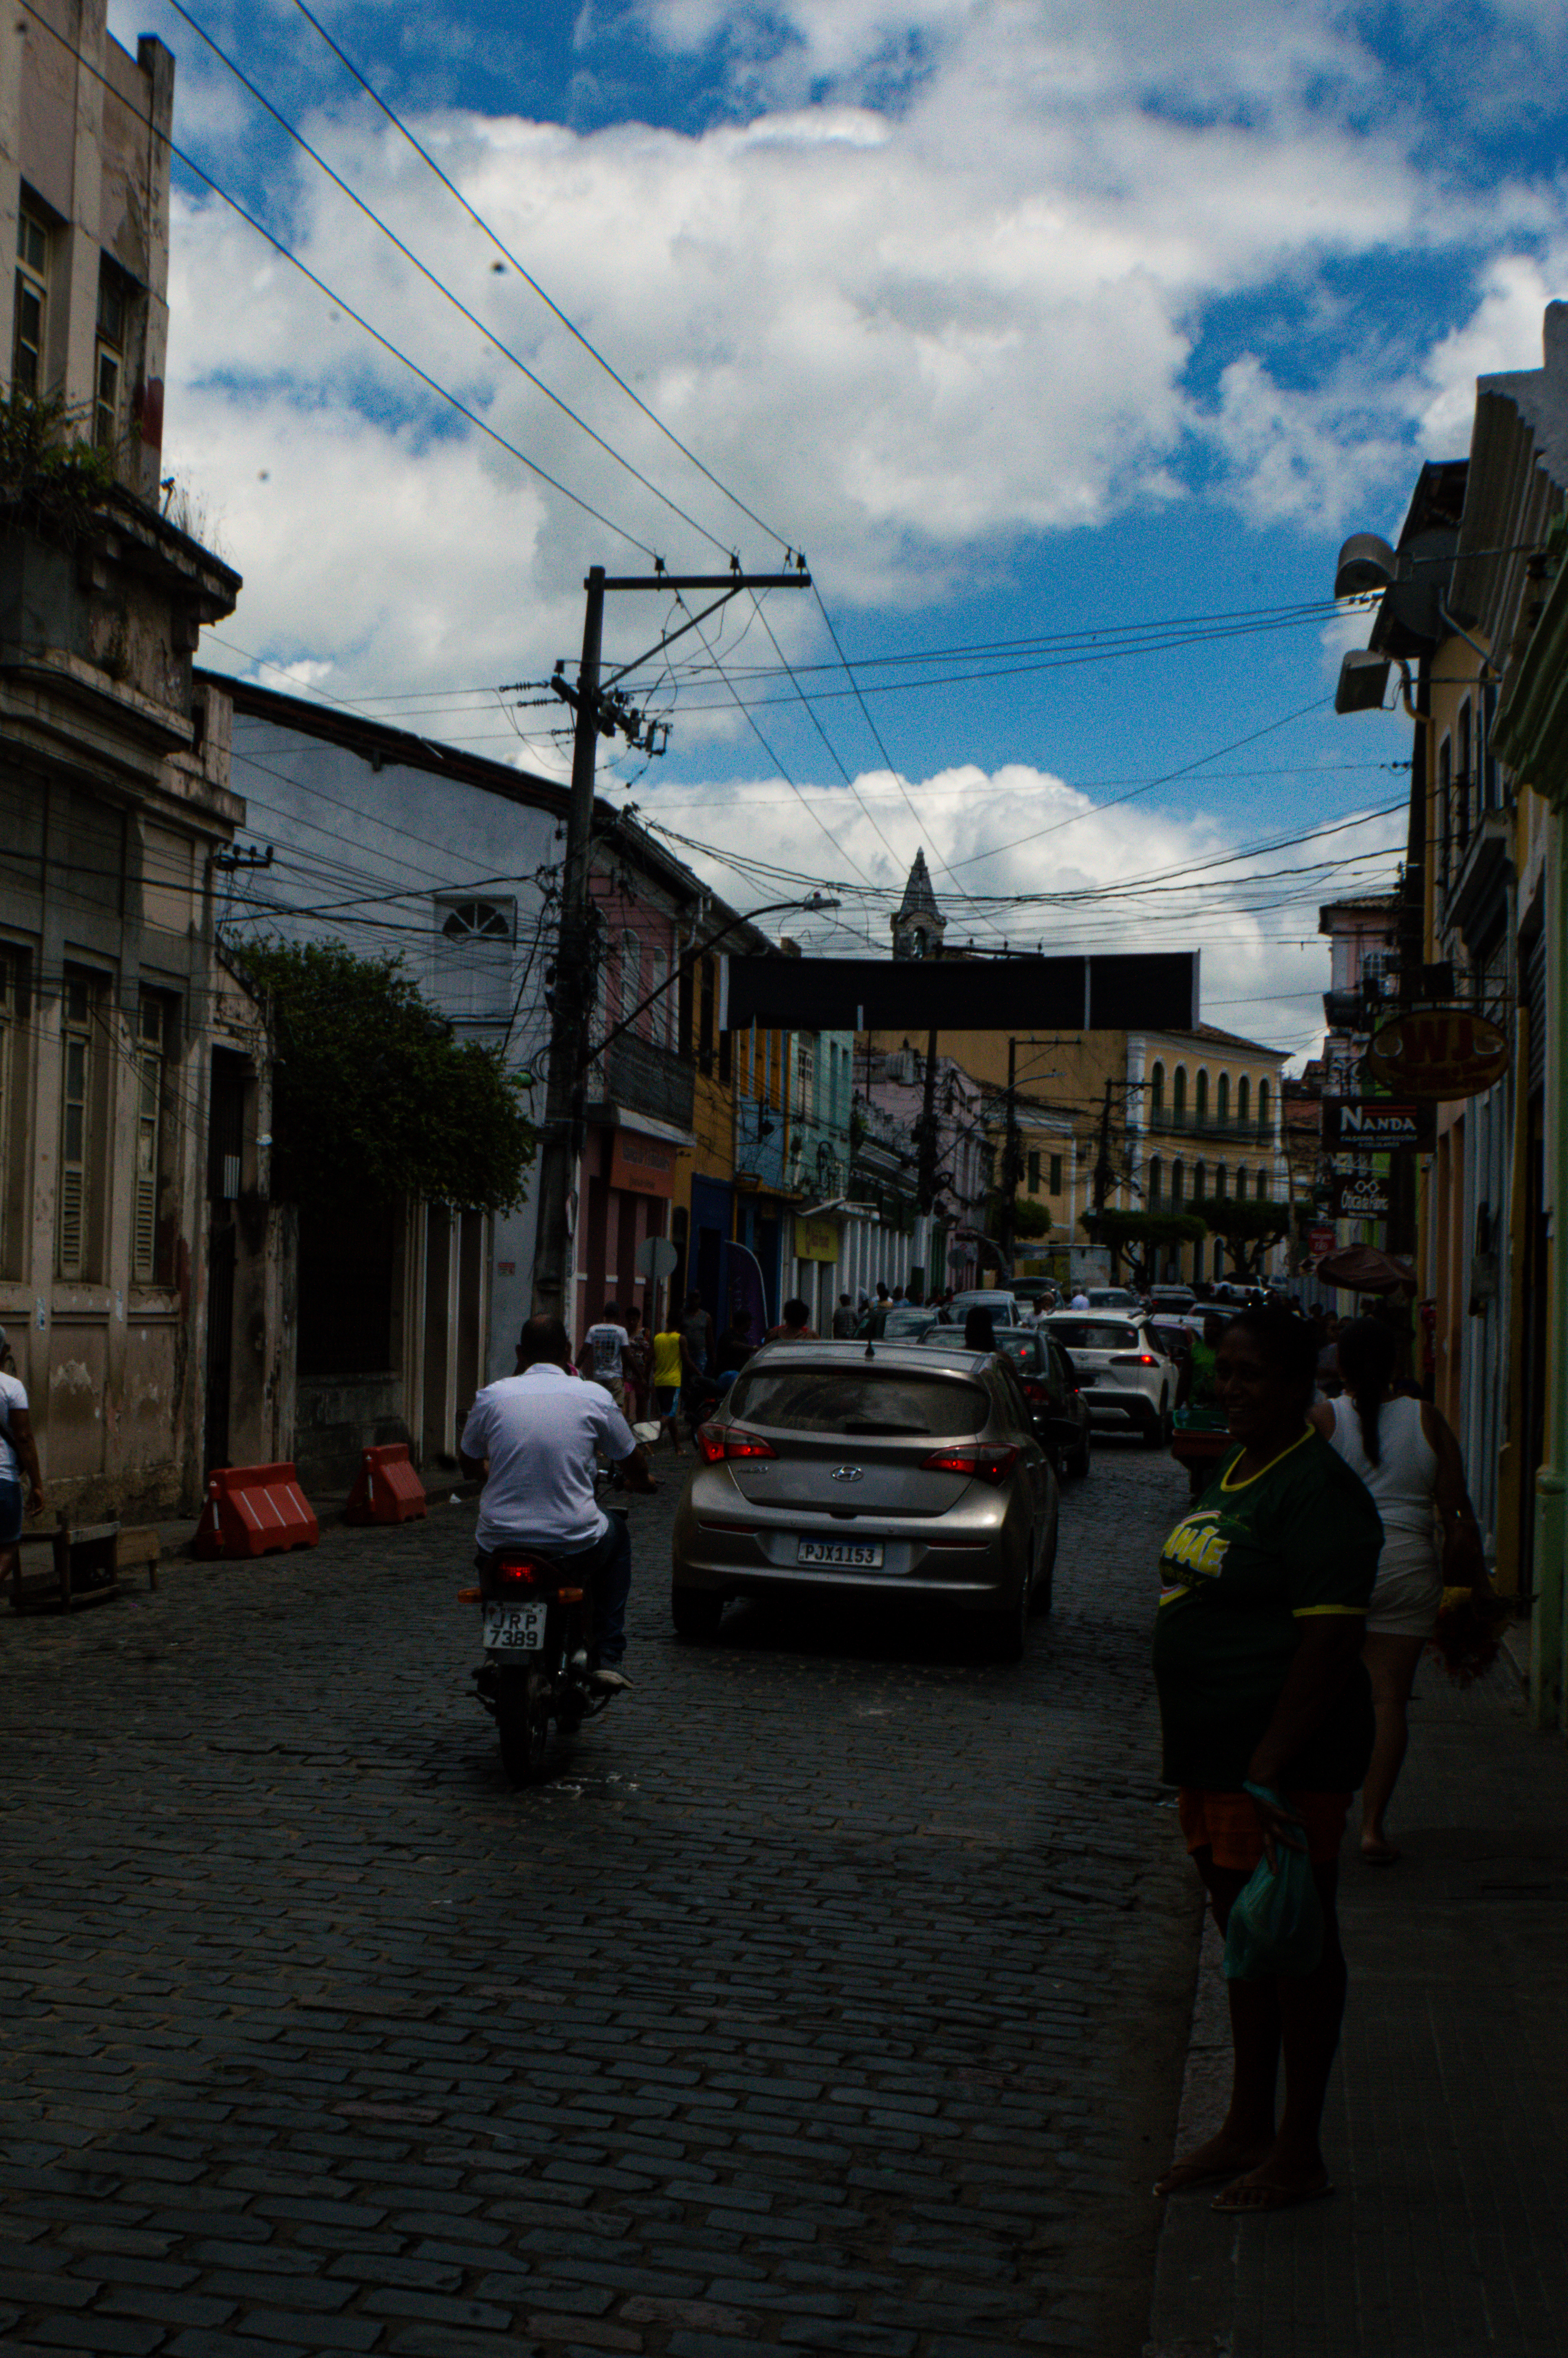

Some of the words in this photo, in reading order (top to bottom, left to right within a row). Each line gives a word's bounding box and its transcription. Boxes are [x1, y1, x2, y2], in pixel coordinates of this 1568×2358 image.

[1401, 1020, 1472, 1062] WJ
[1340, 1105, 1417, 1131] NANDA
[805, 1544, 875, 1563] PJX1I53
[493, 1613, 537, 1630] JRP
[490, 1630, 538, 1647] 7389
